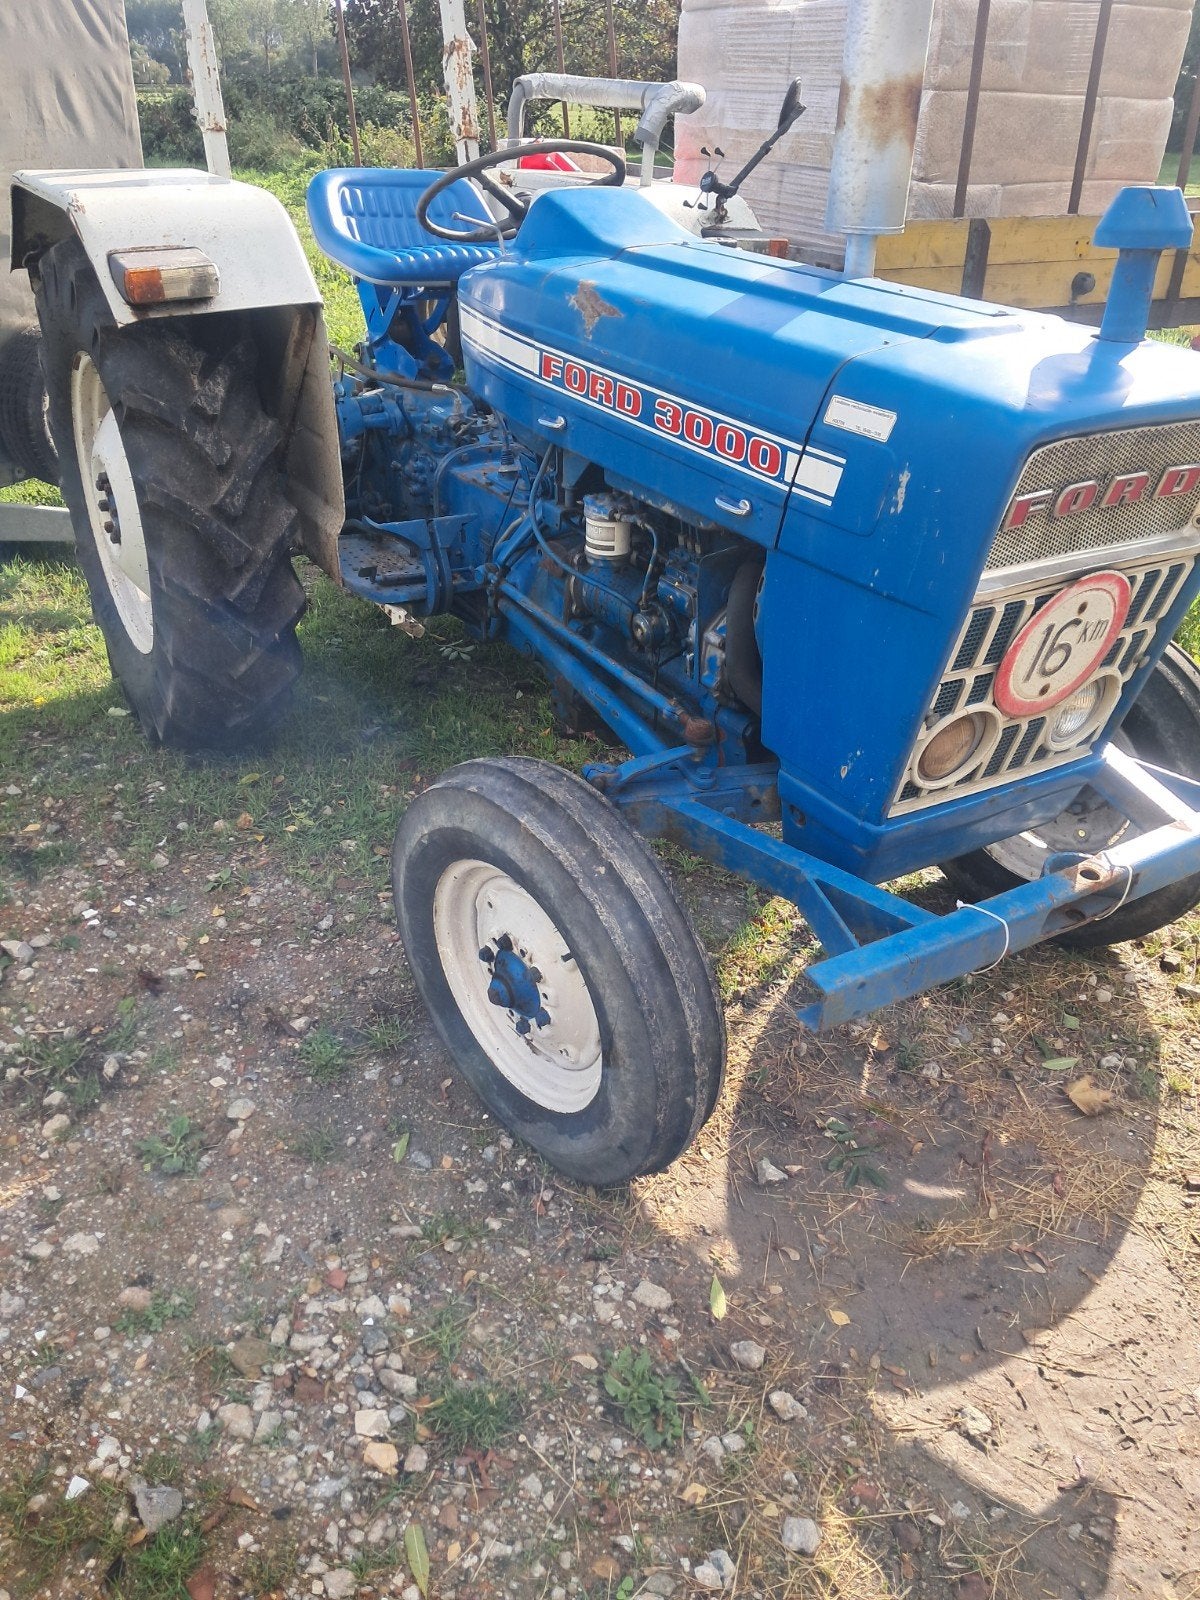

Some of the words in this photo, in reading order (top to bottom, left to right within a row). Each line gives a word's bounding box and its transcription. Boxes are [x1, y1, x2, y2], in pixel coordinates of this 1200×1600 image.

[540, 353, 642, 418] FORD
[654, 398, 782, 477] 3000
[1004, 464, 1200, 530] FORD
[1023, 617, 1083, 683] 16
